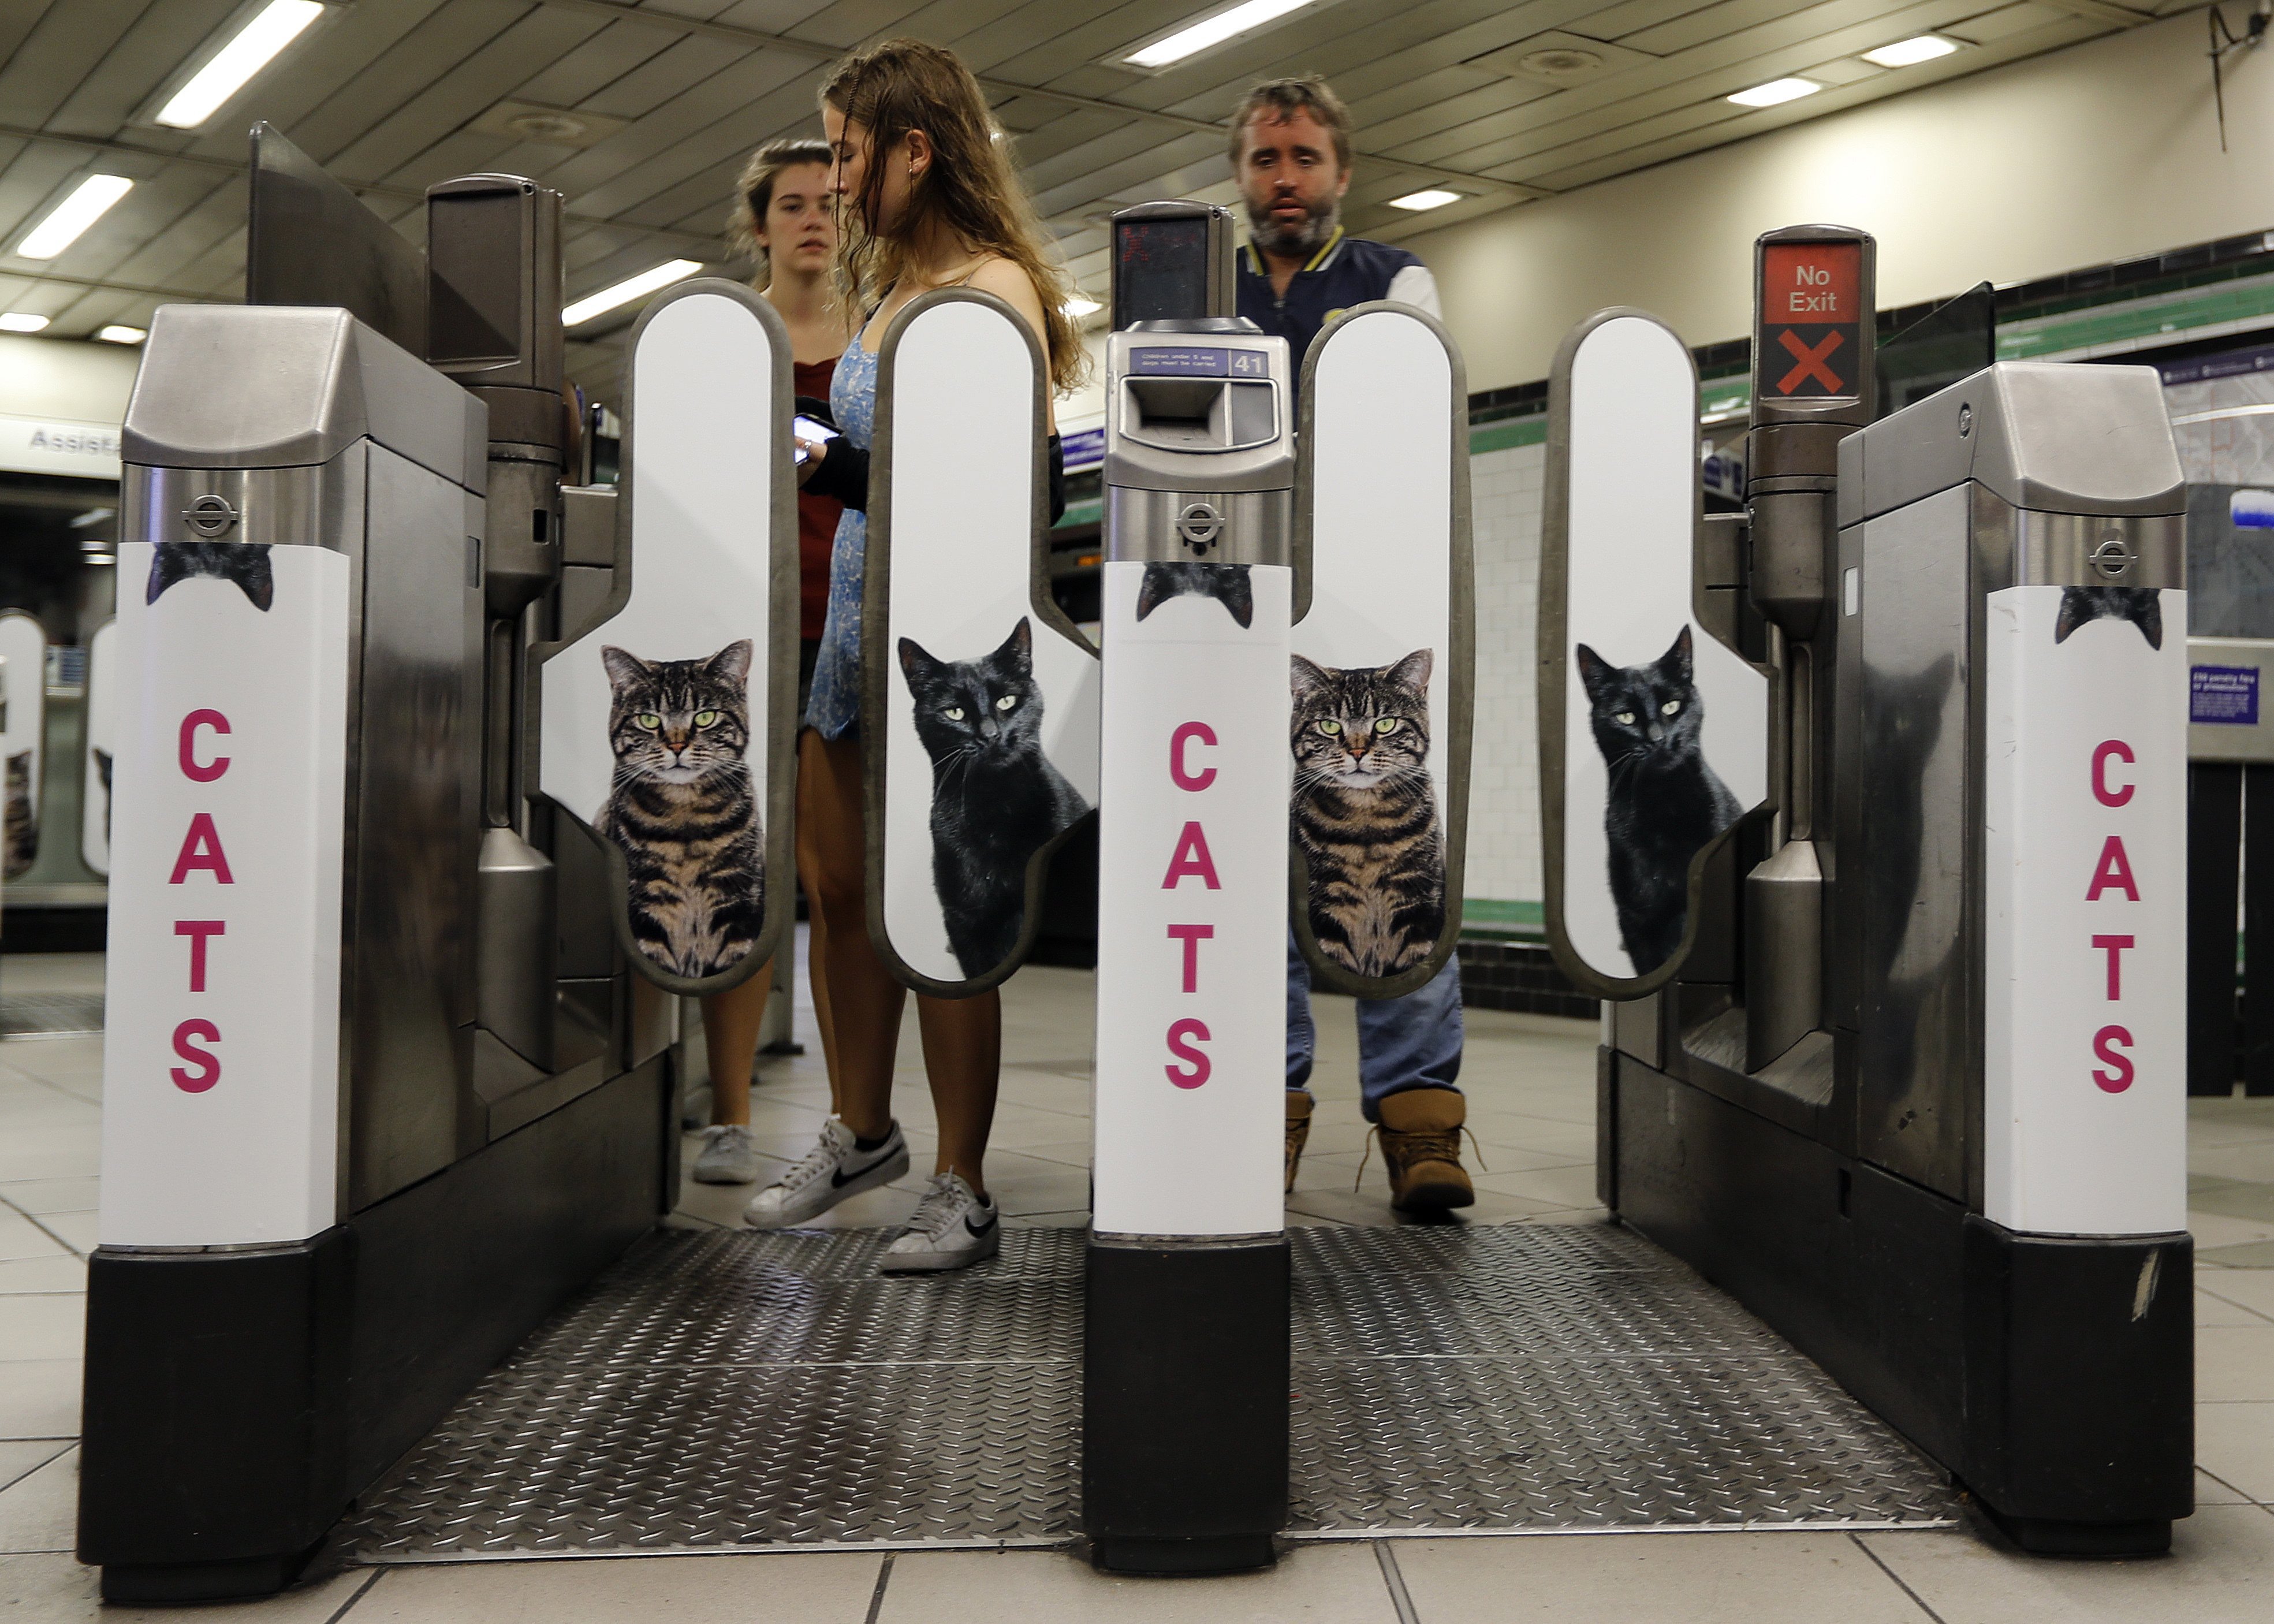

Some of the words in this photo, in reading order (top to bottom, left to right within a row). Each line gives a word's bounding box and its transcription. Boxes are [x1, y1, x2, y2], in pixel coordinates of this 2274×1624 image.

[1234, 355, 1262, 373] 41
[1790, 292, 1837, 312] Exit
[1796, 266, 1830, 286] No
[170, 708, 233, 1093] CATS
[1163, 721, 1220, 1089] CATS
[2086, 740, 2139, 1093] CATS
